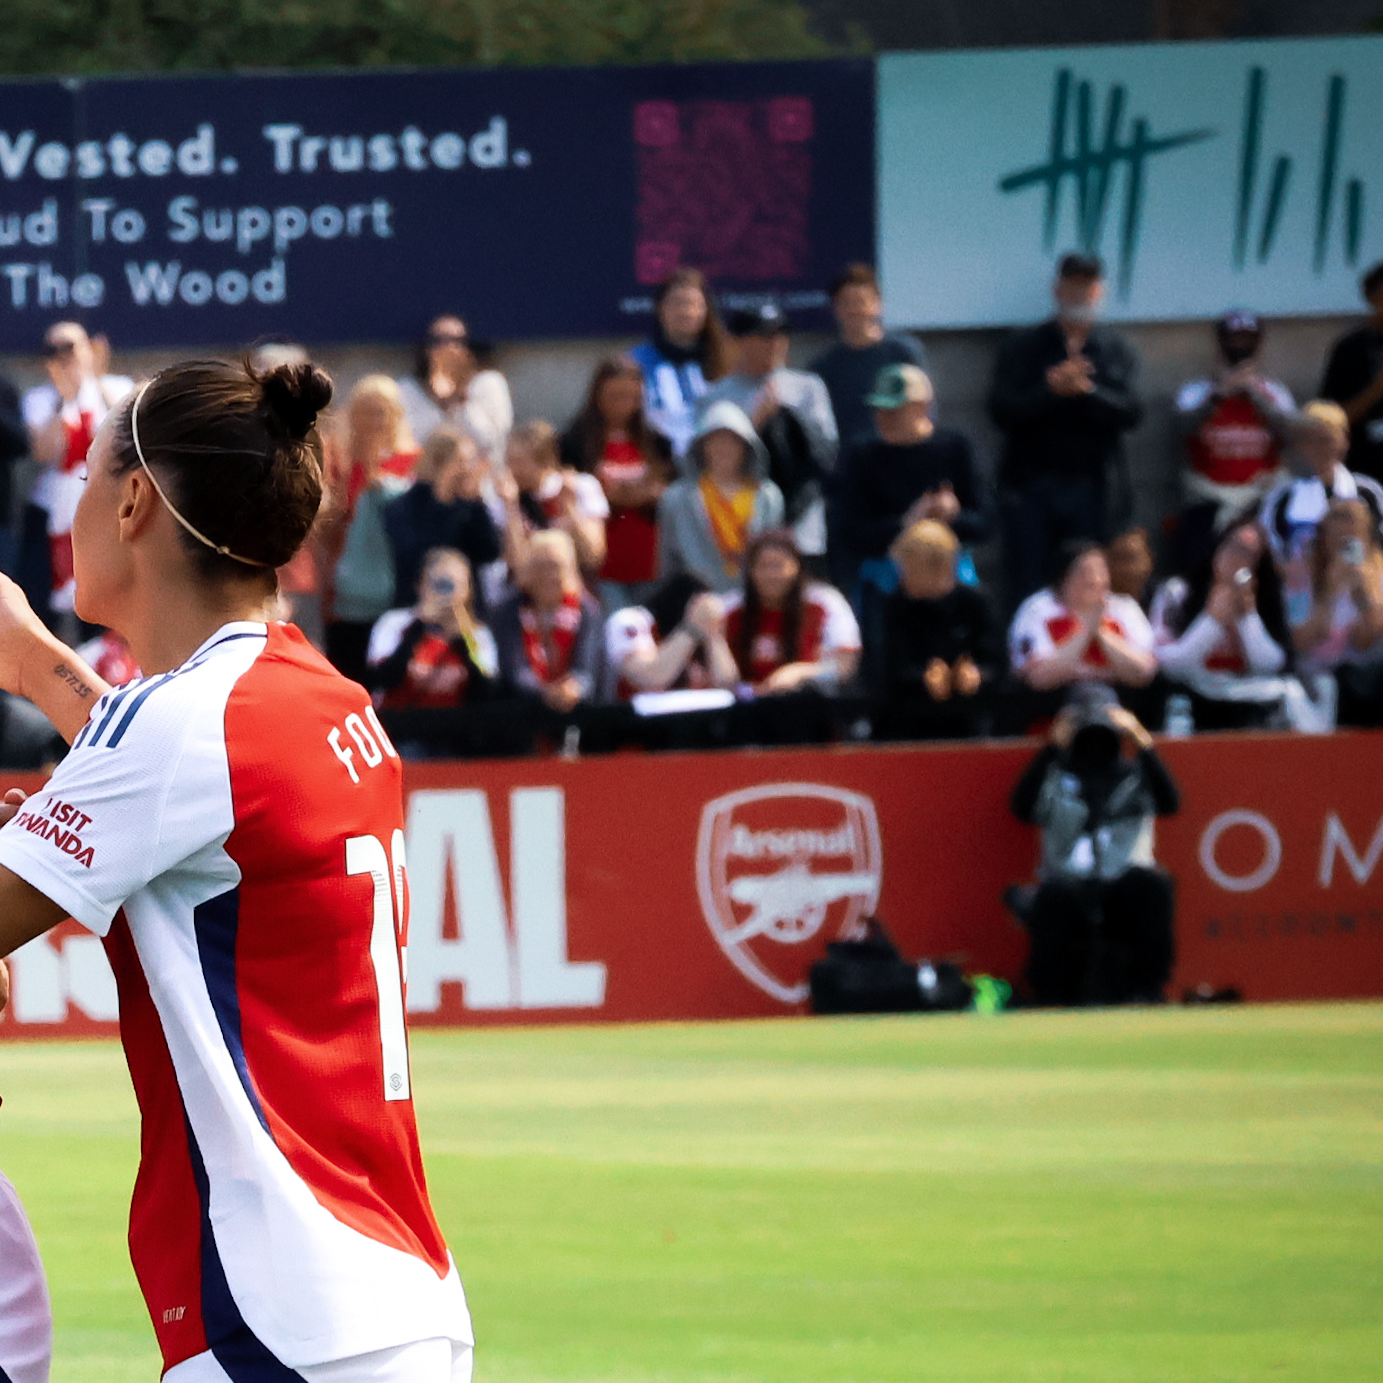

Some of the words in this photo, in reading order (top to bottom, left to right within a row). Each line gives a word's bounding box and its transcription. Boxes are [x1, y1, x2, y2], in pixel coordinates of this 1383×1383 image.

[264, 117, 531, 172] Trusted.
[84, 199, 146, 244] To
[168, 197, 394, 253] Support
[1, 264, 105, 308] The
[126, 258, 287, 304] Wood
[731, 822, 857, 858] Arsenal
